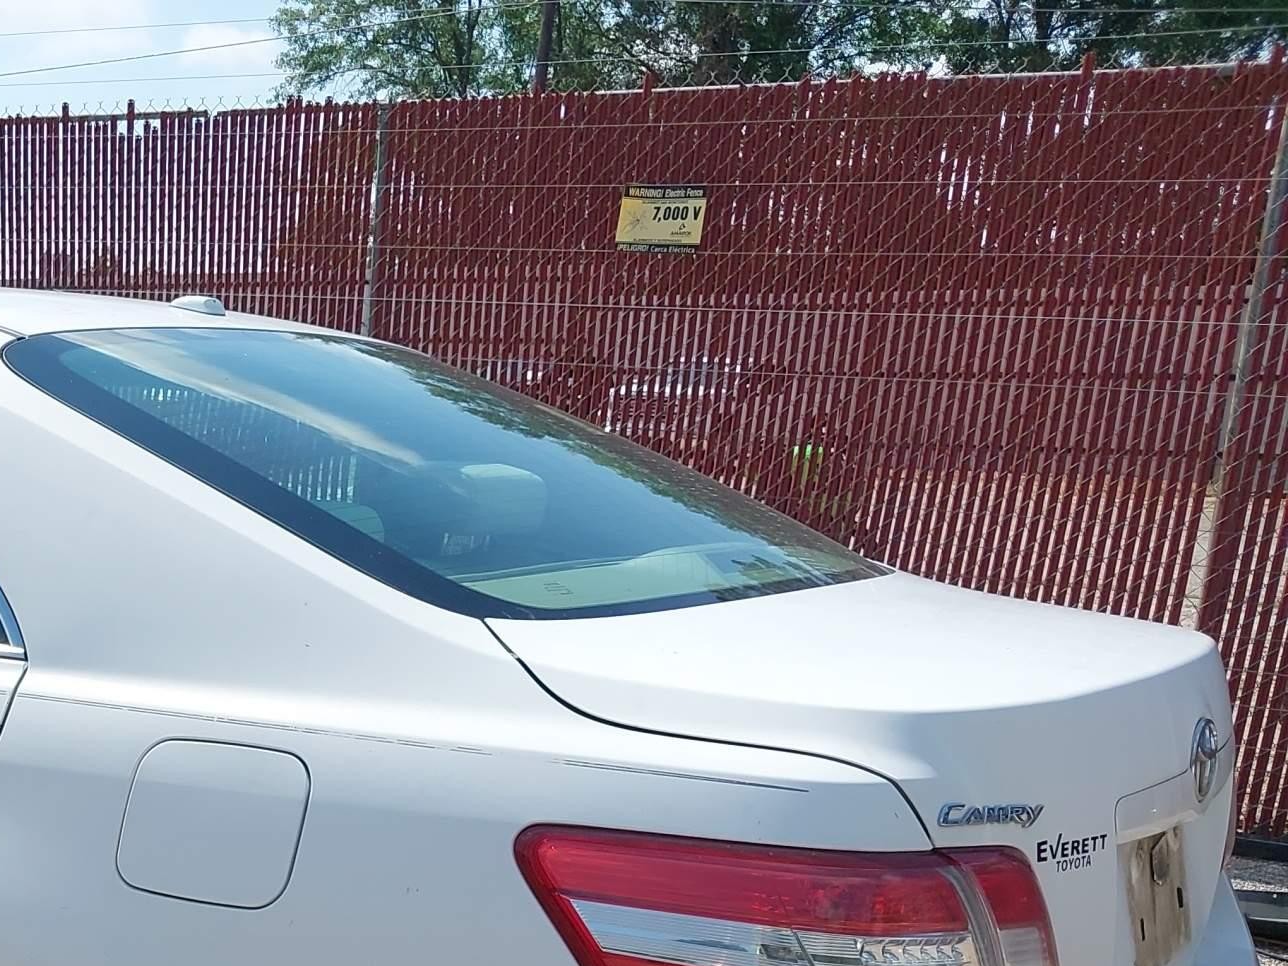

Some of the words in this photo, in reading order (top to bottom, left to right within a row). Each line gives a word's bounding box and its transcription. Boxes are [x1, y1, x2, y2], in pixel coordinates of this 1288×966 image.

[629, 188, 664, 198] WARNING!
[665, 188, 686, 198] Electric
[686, 188, 704, 197] Fence
[653, 206, 689, 223] 7,000
[693, 206, 702, 221] V
[650, 245, 668, 253] Cerca
[937, 802, 1045, 828] CAMRY
[1036, 832, 1108, 864] EVERETT
[1055, 855, 1093, 873] TOYOTA
